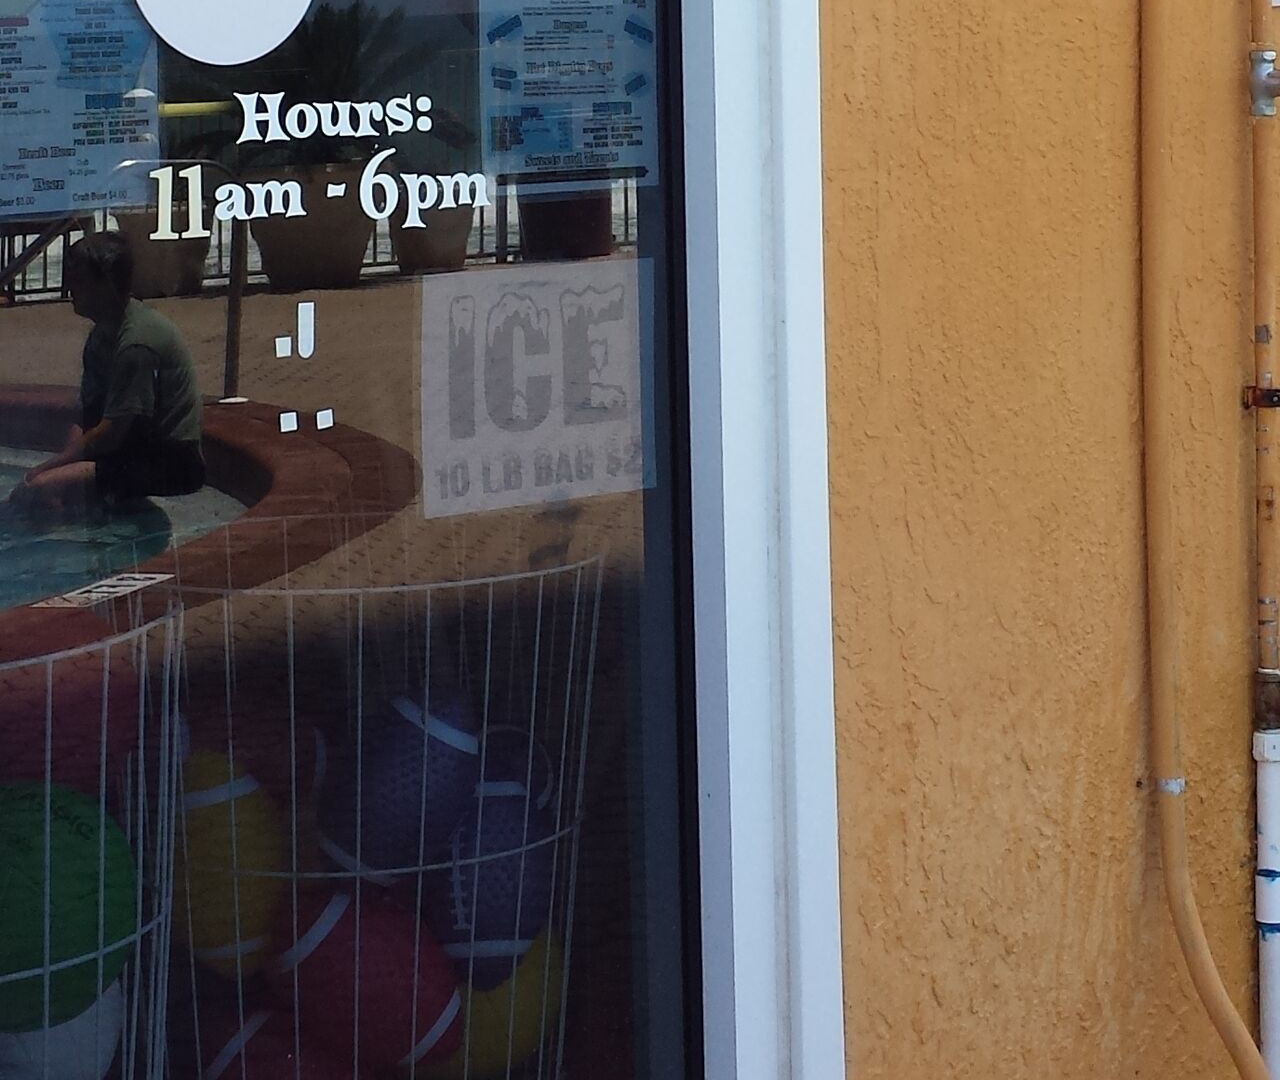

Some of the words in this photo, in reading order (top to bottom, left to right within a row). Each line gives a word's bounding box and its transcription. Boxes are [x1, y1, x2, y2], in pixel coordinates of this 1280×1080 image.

[233, 91, 433, 144] Hours:
[32, 178, 65, 191] Beer
[149, 165, 307, 241] 11am
[359, 148, 491, 229] 6pm
[448, 284, 627, 440] ICE
[434, 458, 470, 499] 10
[482, 452, 523, 493] LB
[533, 440, 595, 487] BAG
